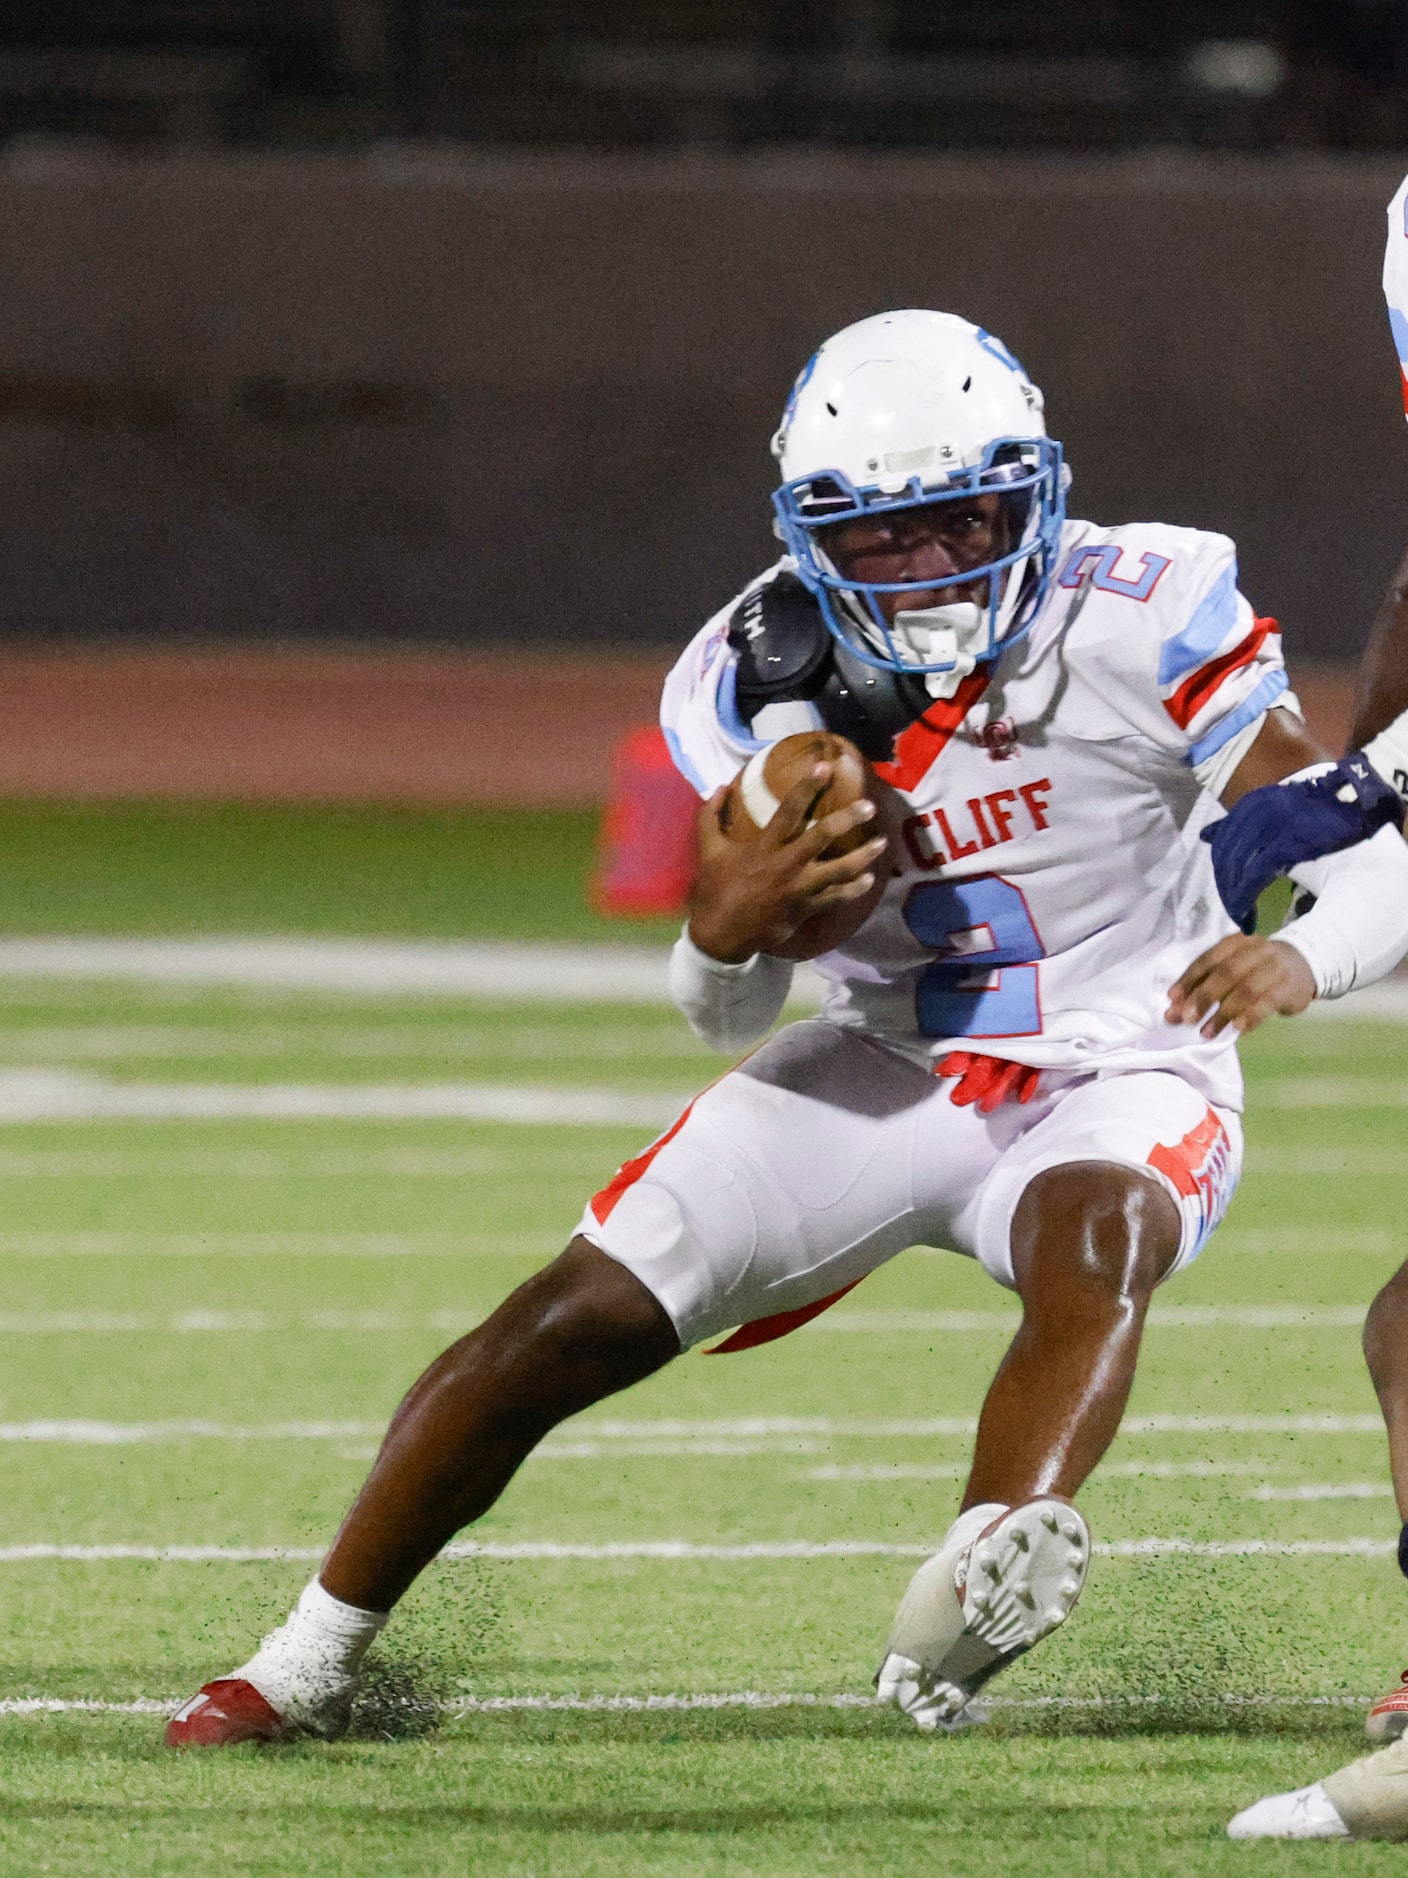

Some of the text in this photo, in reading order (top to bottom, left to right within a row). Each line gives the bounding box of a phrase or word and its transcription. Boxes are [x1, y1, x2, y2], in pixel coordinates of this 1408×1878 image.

[1058, 544, 1174, 603] 2
[902, 777, 1053, 871] CLIFF
[901, 871, 1047, 1040] 2
